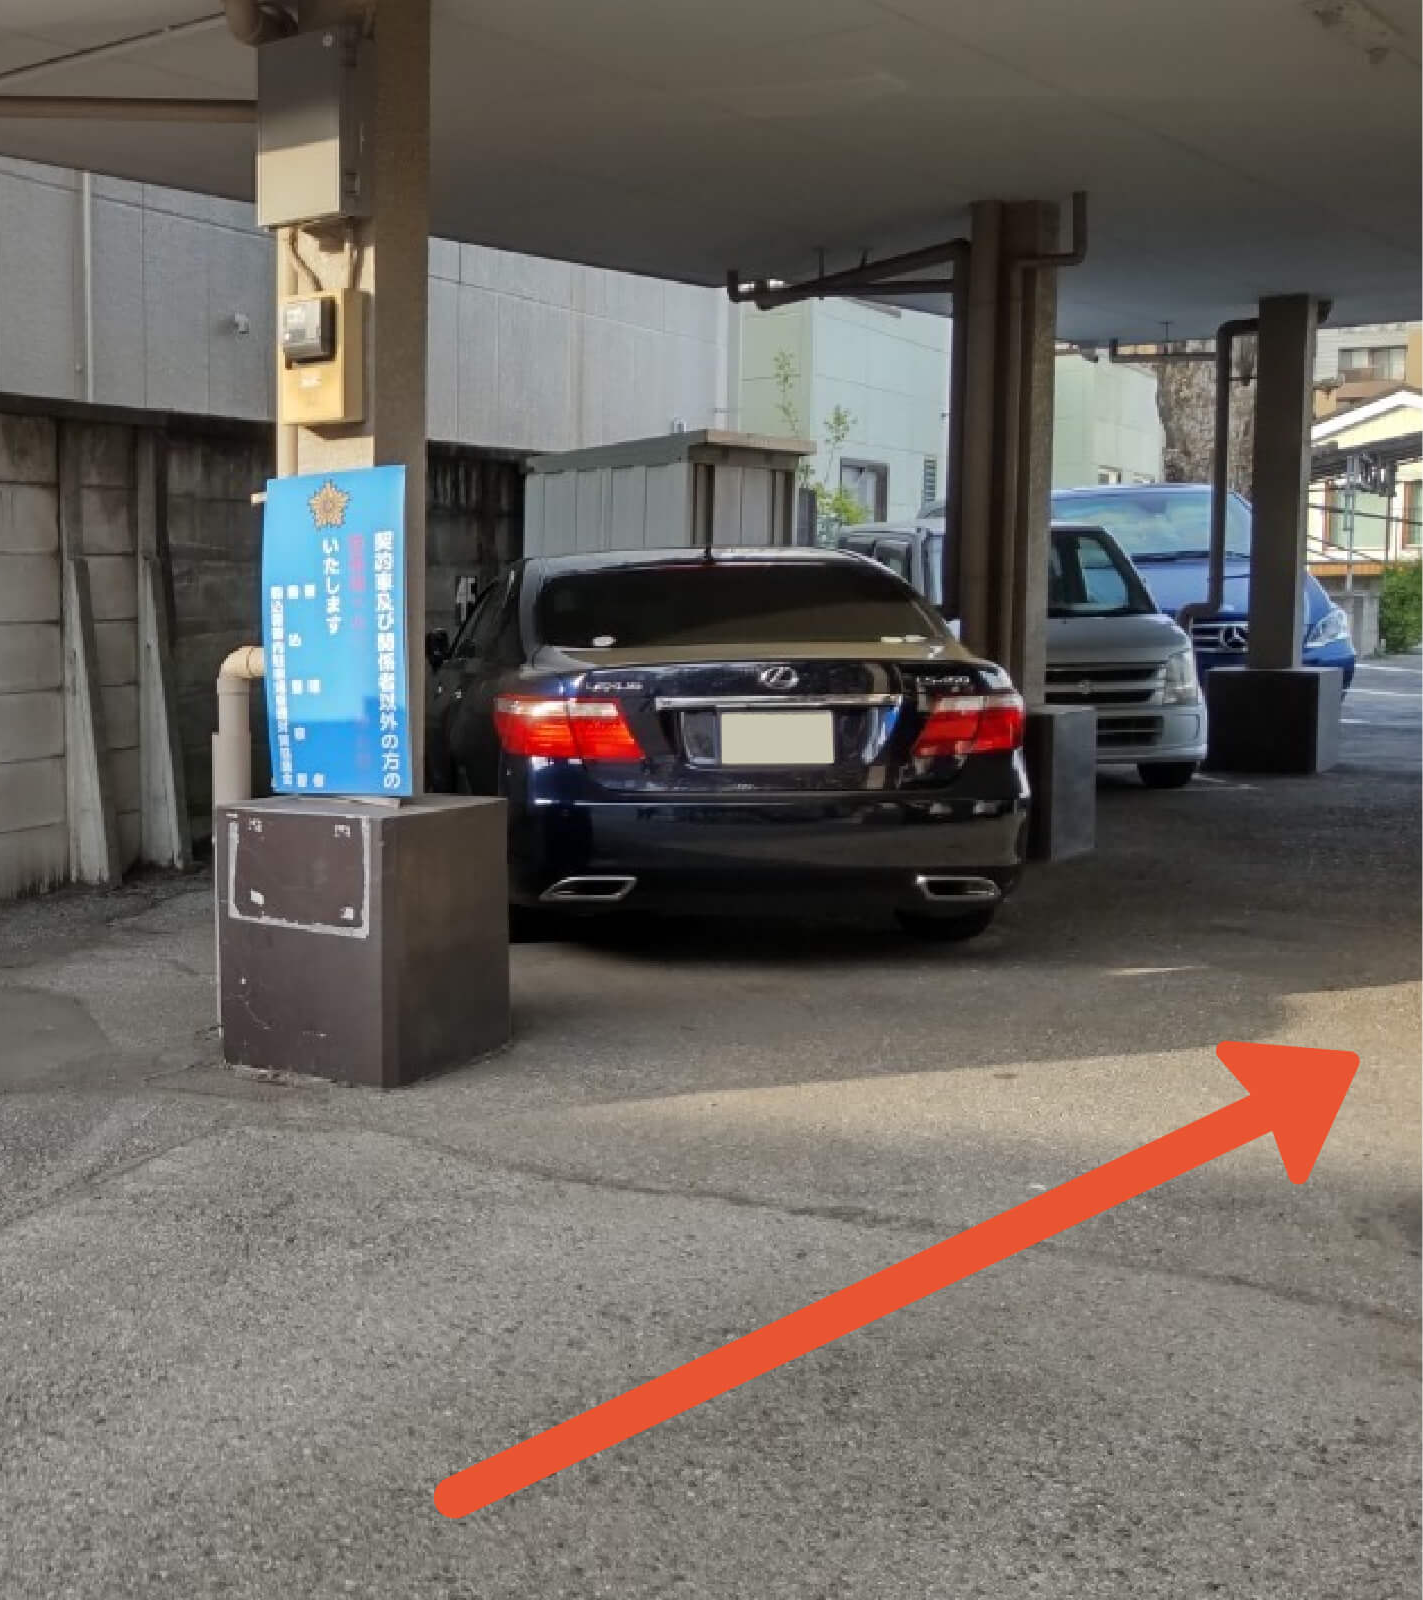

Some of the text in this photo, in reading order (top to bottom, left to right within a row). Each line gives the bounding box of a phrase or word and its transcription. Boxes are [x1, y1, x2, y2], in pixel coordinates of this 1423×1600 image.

[322, 538, 341, 636] いたします
